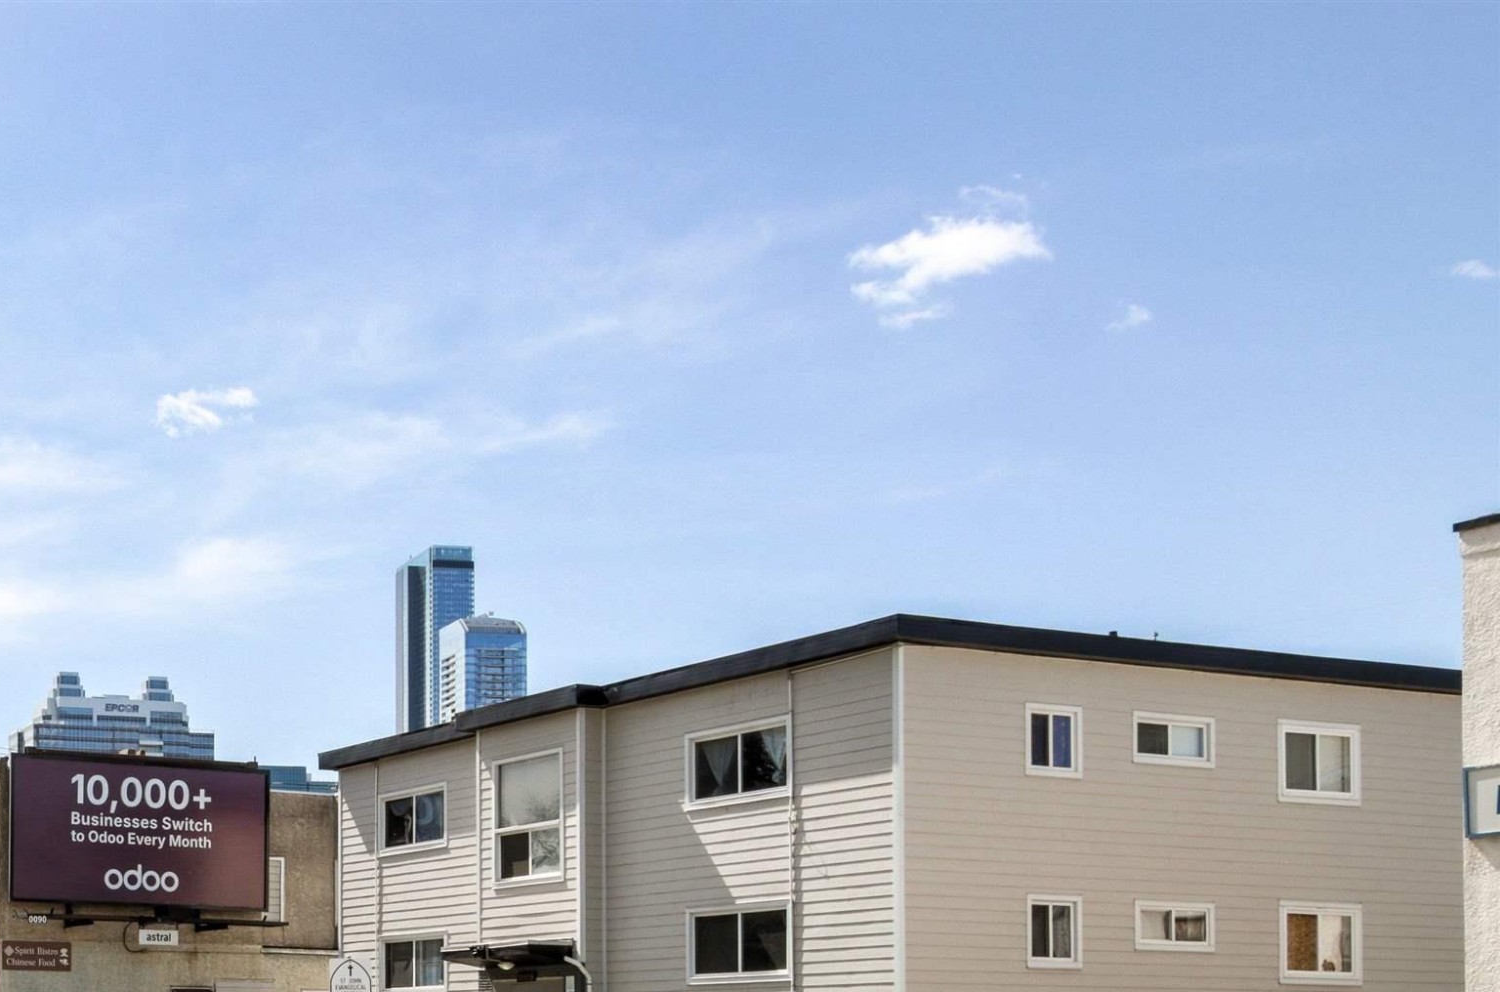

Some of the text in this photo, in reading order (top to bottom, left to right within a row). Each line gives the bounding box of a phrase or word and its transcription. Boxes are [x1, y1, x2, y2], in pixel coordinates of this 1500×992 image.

[71, 773, 212, 814] 10,000+
[70, 811, 213, 832] Businesses Switch
[71, 830, 212, 849] to Odoo Every Month
[104, 864, 180, 893] odoo
[28, 915, 47, 924] 0090
[146, 932, 172, 942] astral
[14, 945, 59, 956] Spirit Bistro
[6, 957, 56, 967] Chinese Food
